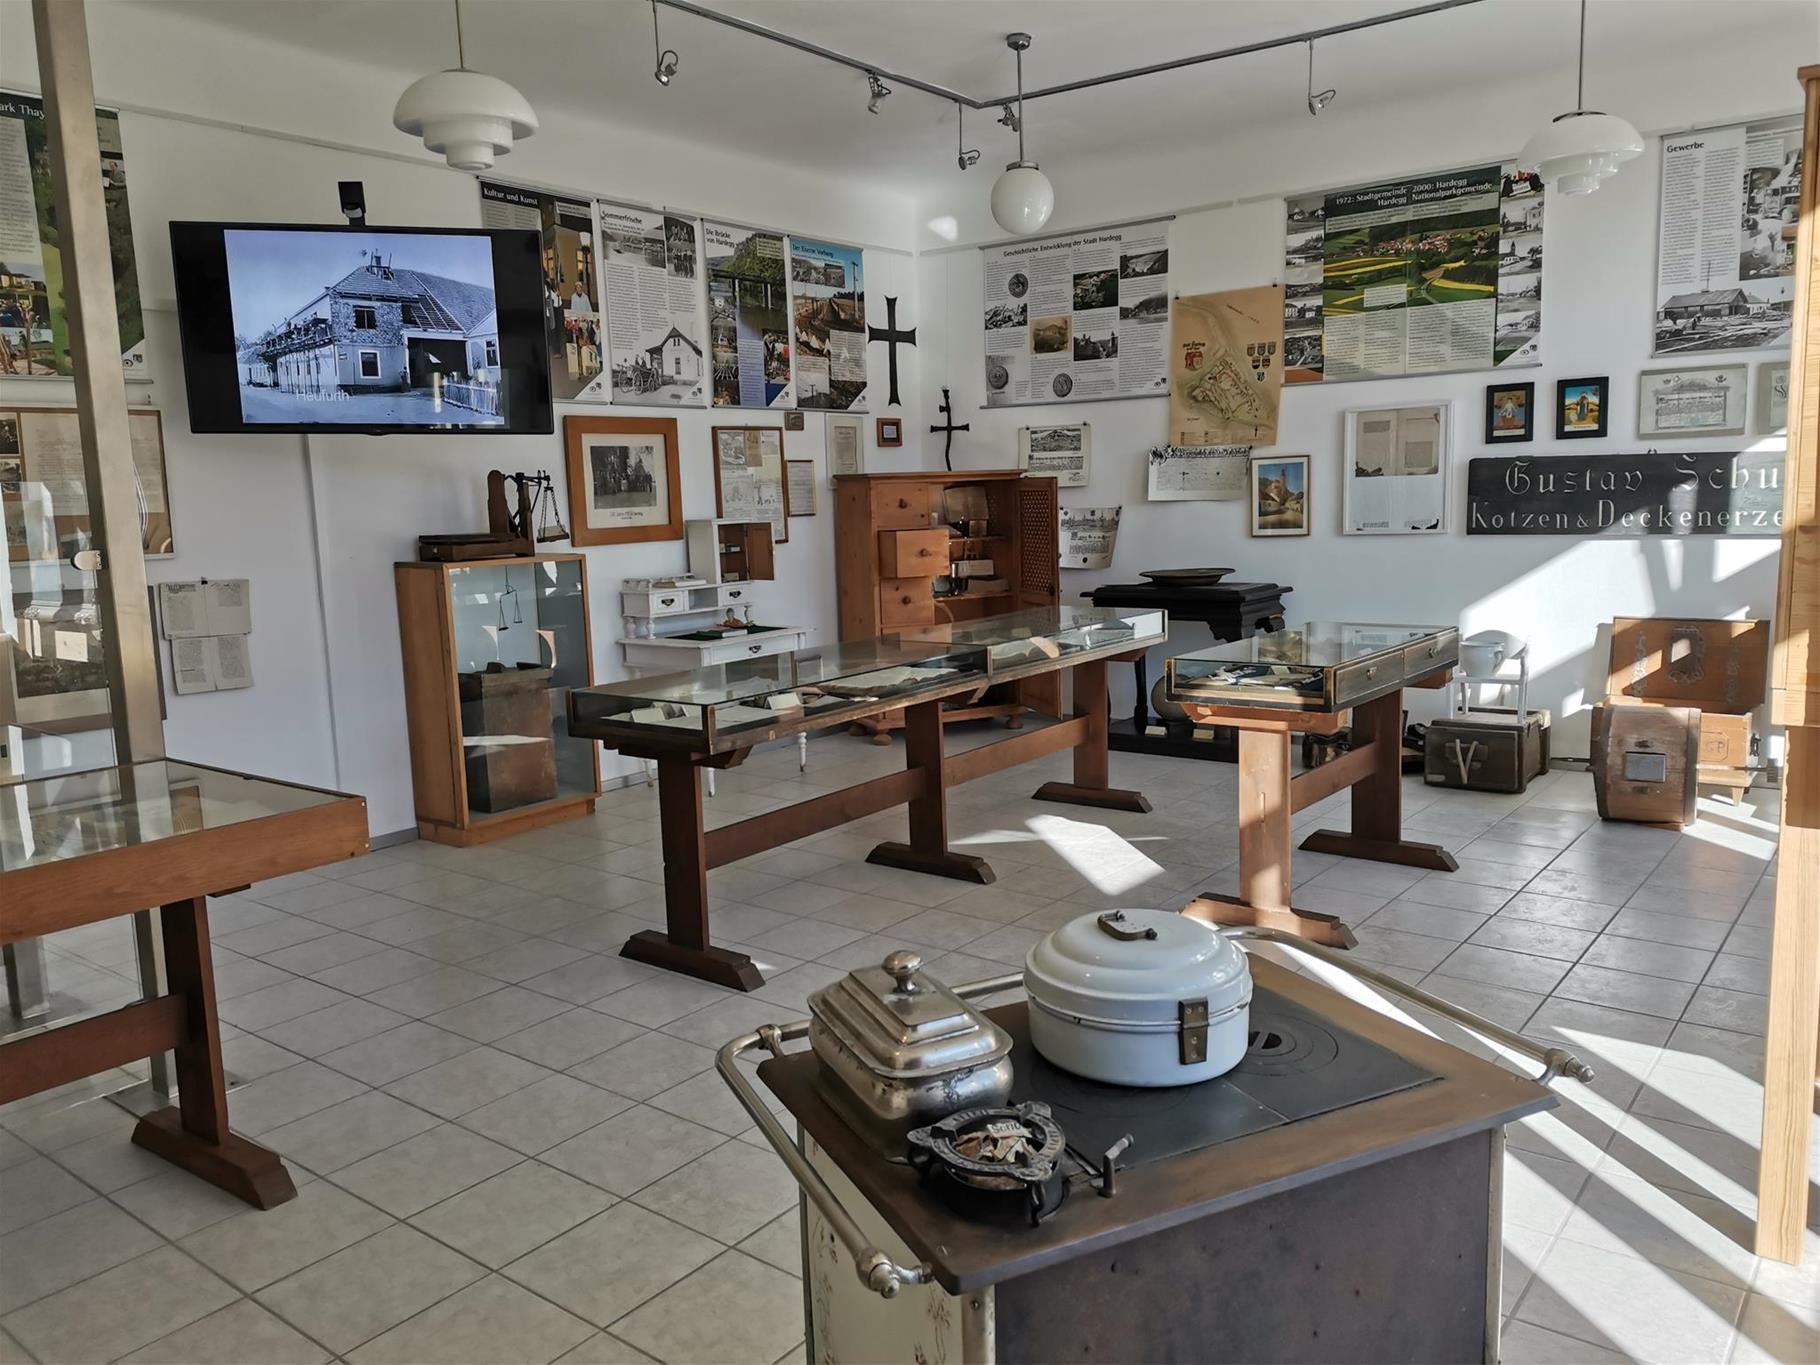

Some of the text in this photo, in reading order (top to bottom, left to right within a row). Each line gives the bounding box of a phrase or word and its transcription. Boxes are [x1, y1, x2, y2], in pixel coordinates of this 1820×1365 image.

[1666, 141, 1705, 154] Gewerbe
[1412, 178, 1468, 193] 2000: Hardegg
[1412, 182, 1493, 201] Nationalparkgemeinde
[484, 187, 538, 206] Kultur und Kunst
[1336, 185, 1408, 206] 1972: Stadtgemeinde
[1377, 196, 1408, 206] Hardegg
[601, 210, 642, 225] Sommerfrische
[1040, 241, 1072, 252] Entwicklung
[1505, 453, 1779, 495] Gustav Schu
[1598, 498, 1784, 529] Deckenerze
